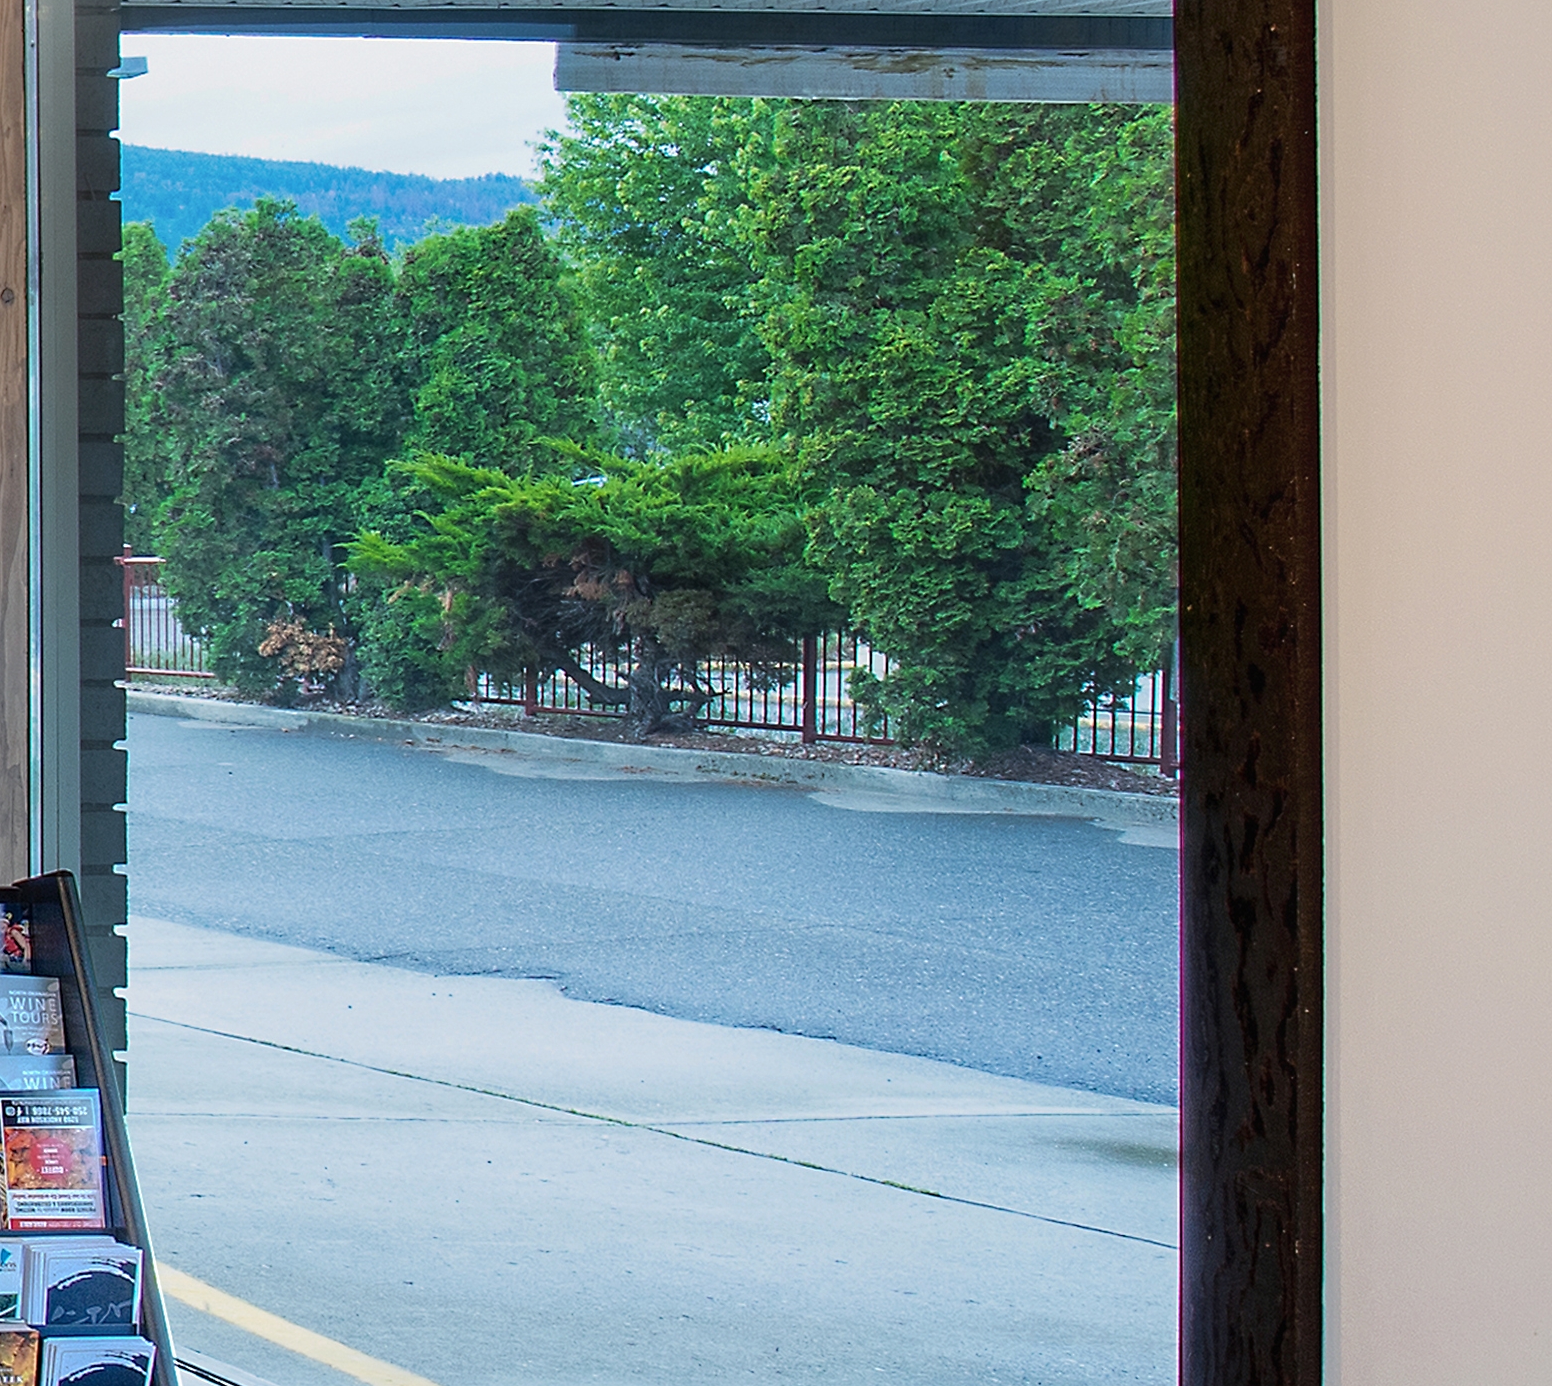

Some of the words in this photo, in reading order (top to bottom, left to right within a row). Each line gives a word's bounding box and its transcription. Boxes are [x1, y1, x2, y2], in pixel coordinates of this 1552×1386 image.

[9, 997, 56, 1011] WINE
[11, 1012, 58, 1024] TOURS
[23, 1076, 71, 1089] WINE
